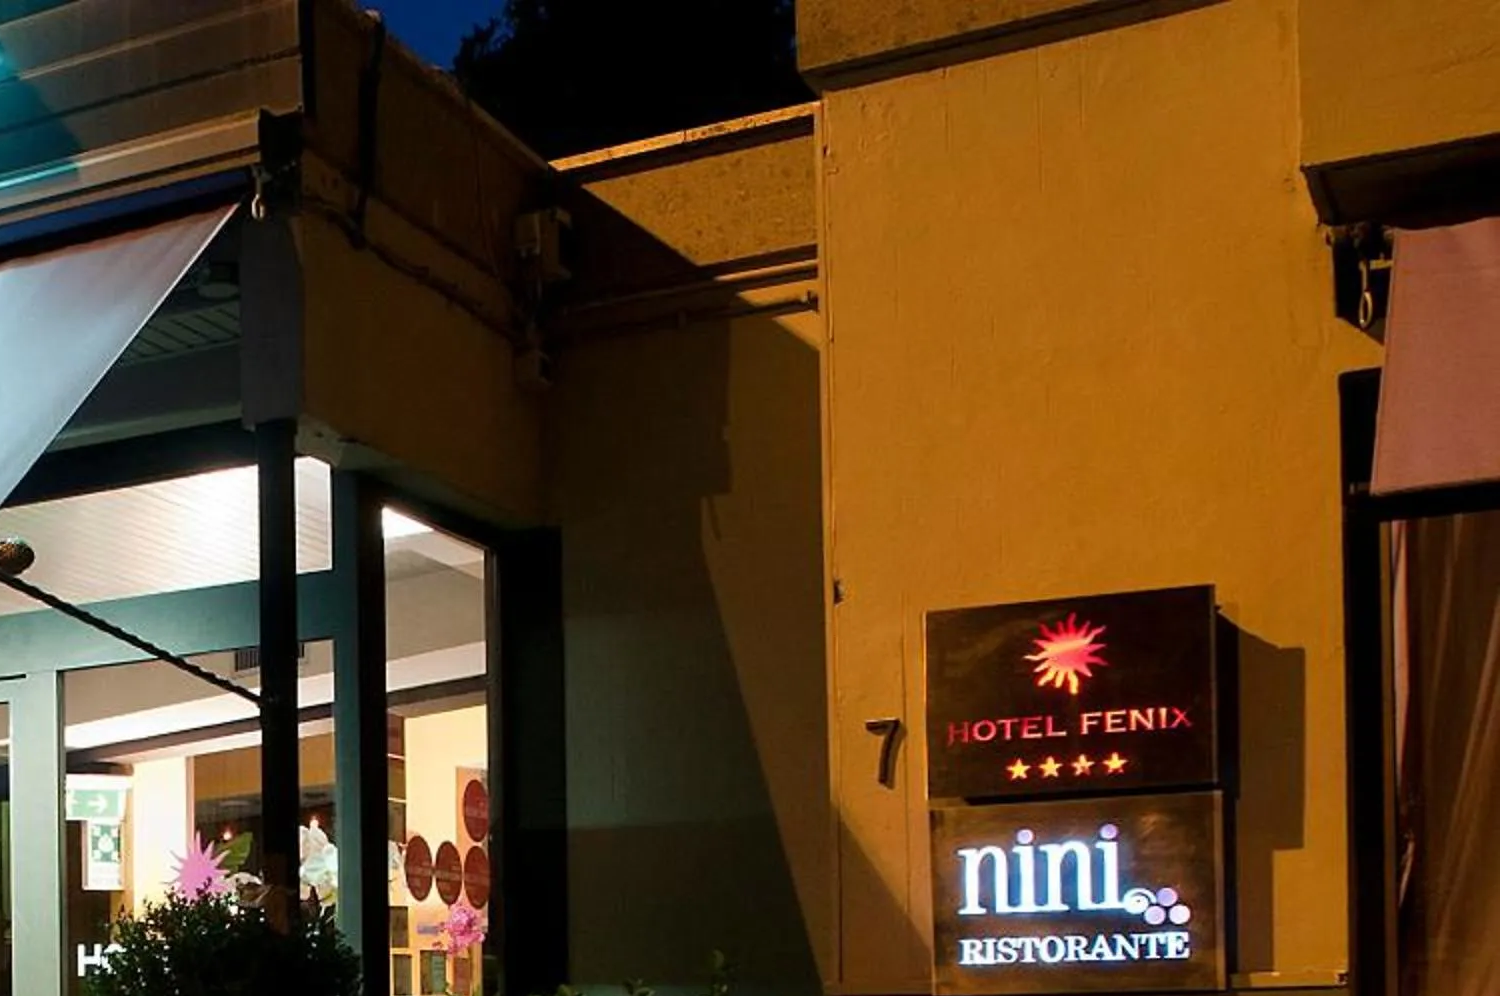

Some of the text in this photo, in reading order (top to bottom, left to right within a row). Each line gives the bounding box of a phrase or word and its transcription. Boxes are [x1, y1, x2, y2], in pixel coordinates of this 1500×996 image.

[864, 718, 904, 790] 7
[947, 706, 1193, 747] HOTEL FENIX
[957, 823, 1140, 915] nini
[958, 931, 1190, 965] RISTORANTE
